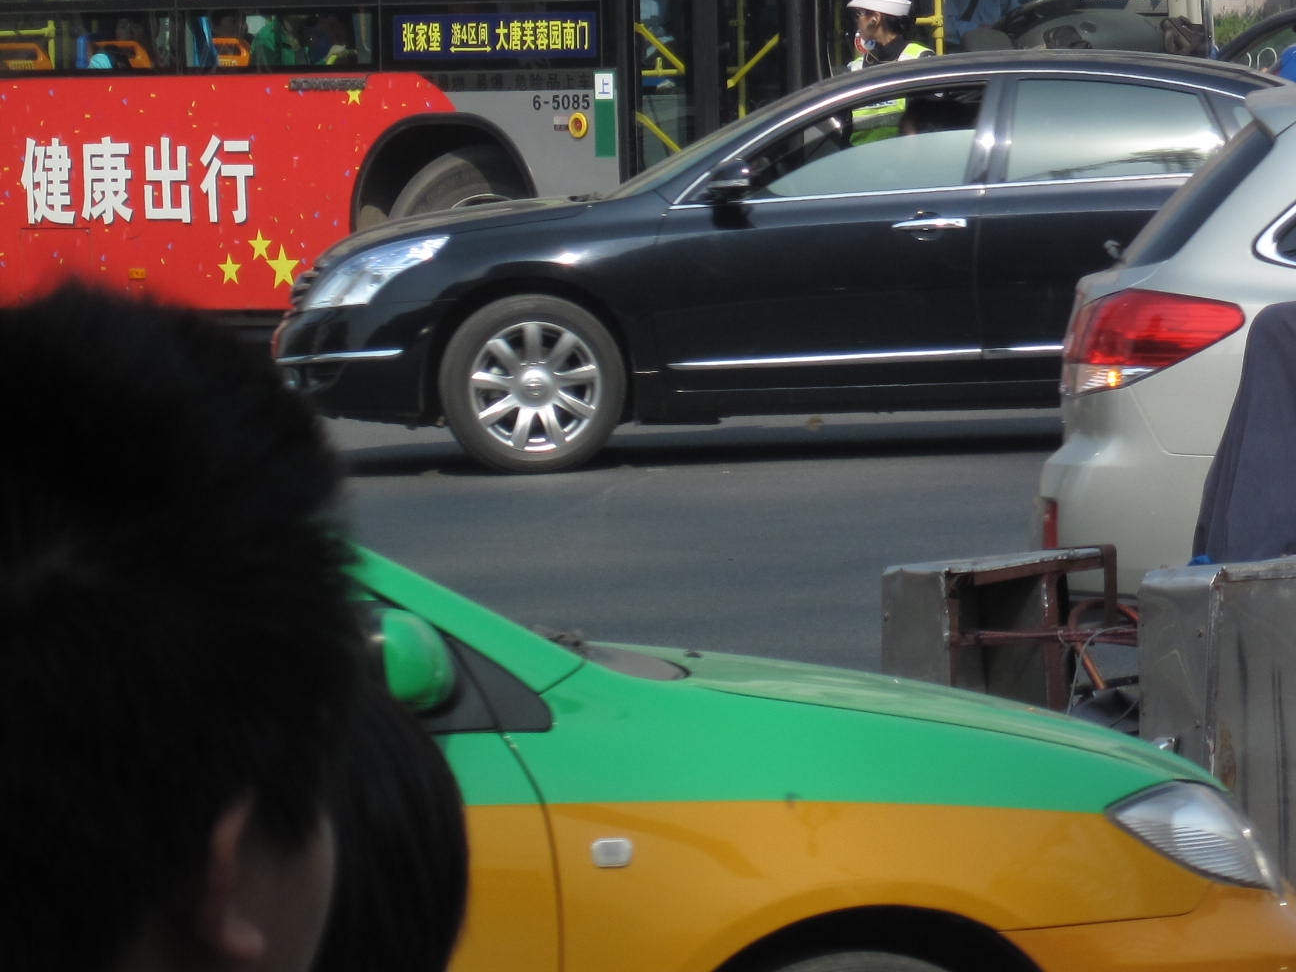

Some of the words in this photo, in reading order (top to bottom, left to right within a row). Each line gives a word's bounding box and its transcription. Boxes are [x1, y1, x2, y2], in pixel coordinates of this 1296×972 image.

[402, 22, 441, 52] 张家堡
[451, 22, 488, 45] 游4区间
[495, 20, 589, 51] 大唐芙蓉园南门
[598, 78, 611, 94] 上
[532, 94, 590, 111] 6-5085
[21, 135, 254, 225] 健康出行
